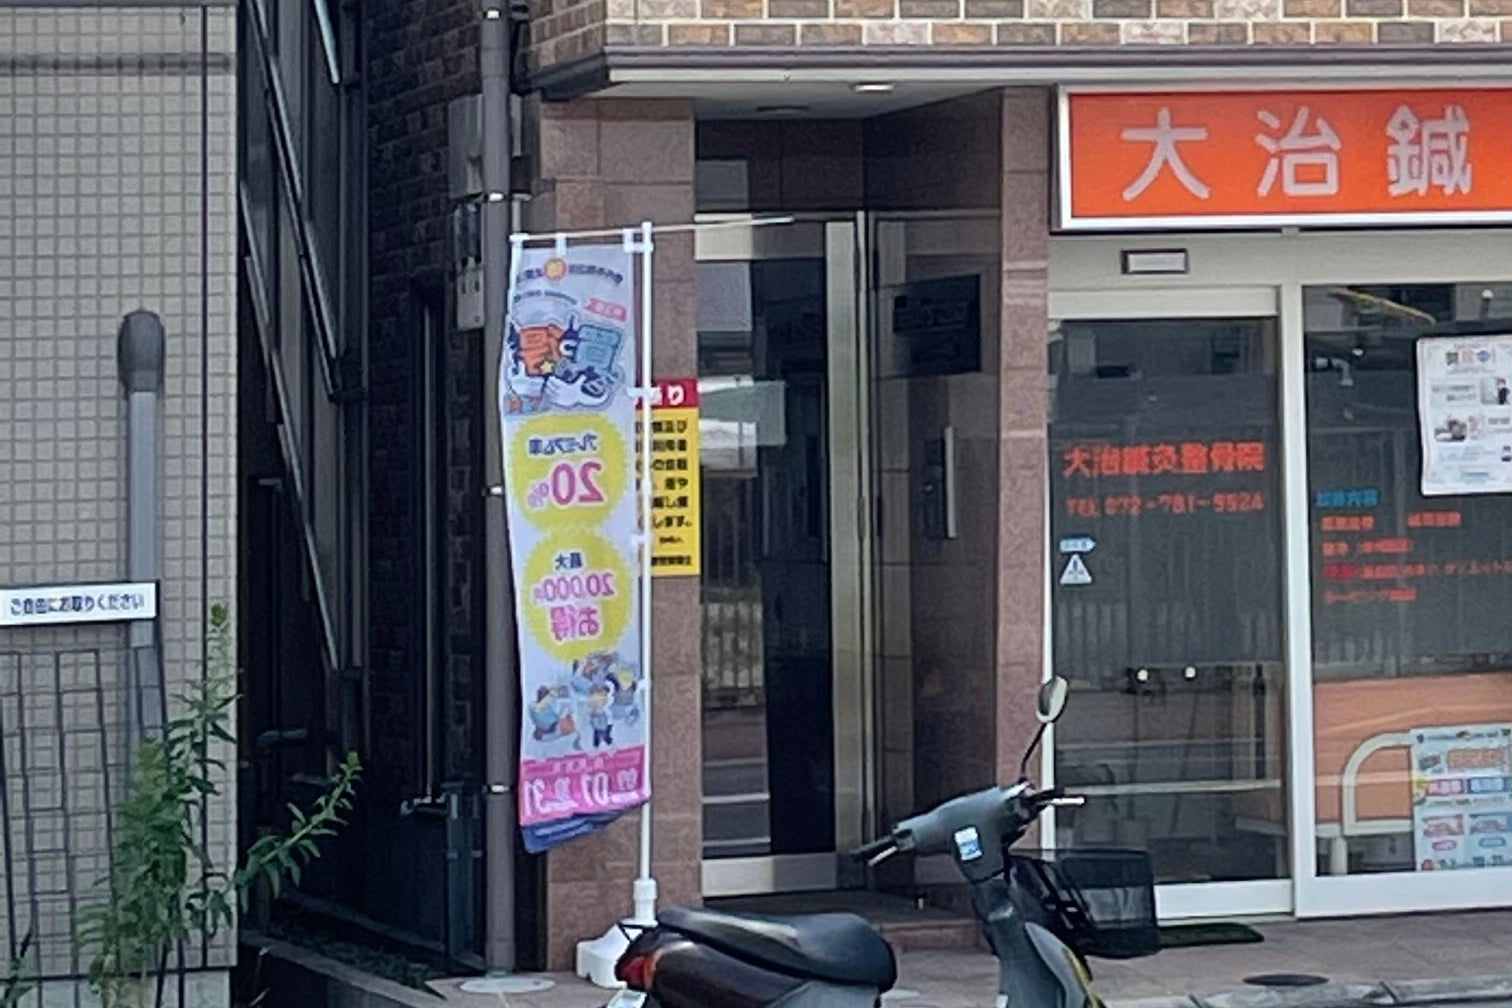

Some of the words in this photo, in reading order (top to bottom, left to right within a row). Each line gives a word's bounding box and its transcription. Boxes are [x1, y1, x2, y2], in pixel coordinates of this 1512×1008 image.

[1062, 441, 1266, 479] 大治鍼灸整骨院
[10, 593, 145, 616] ご自由にお取りください
